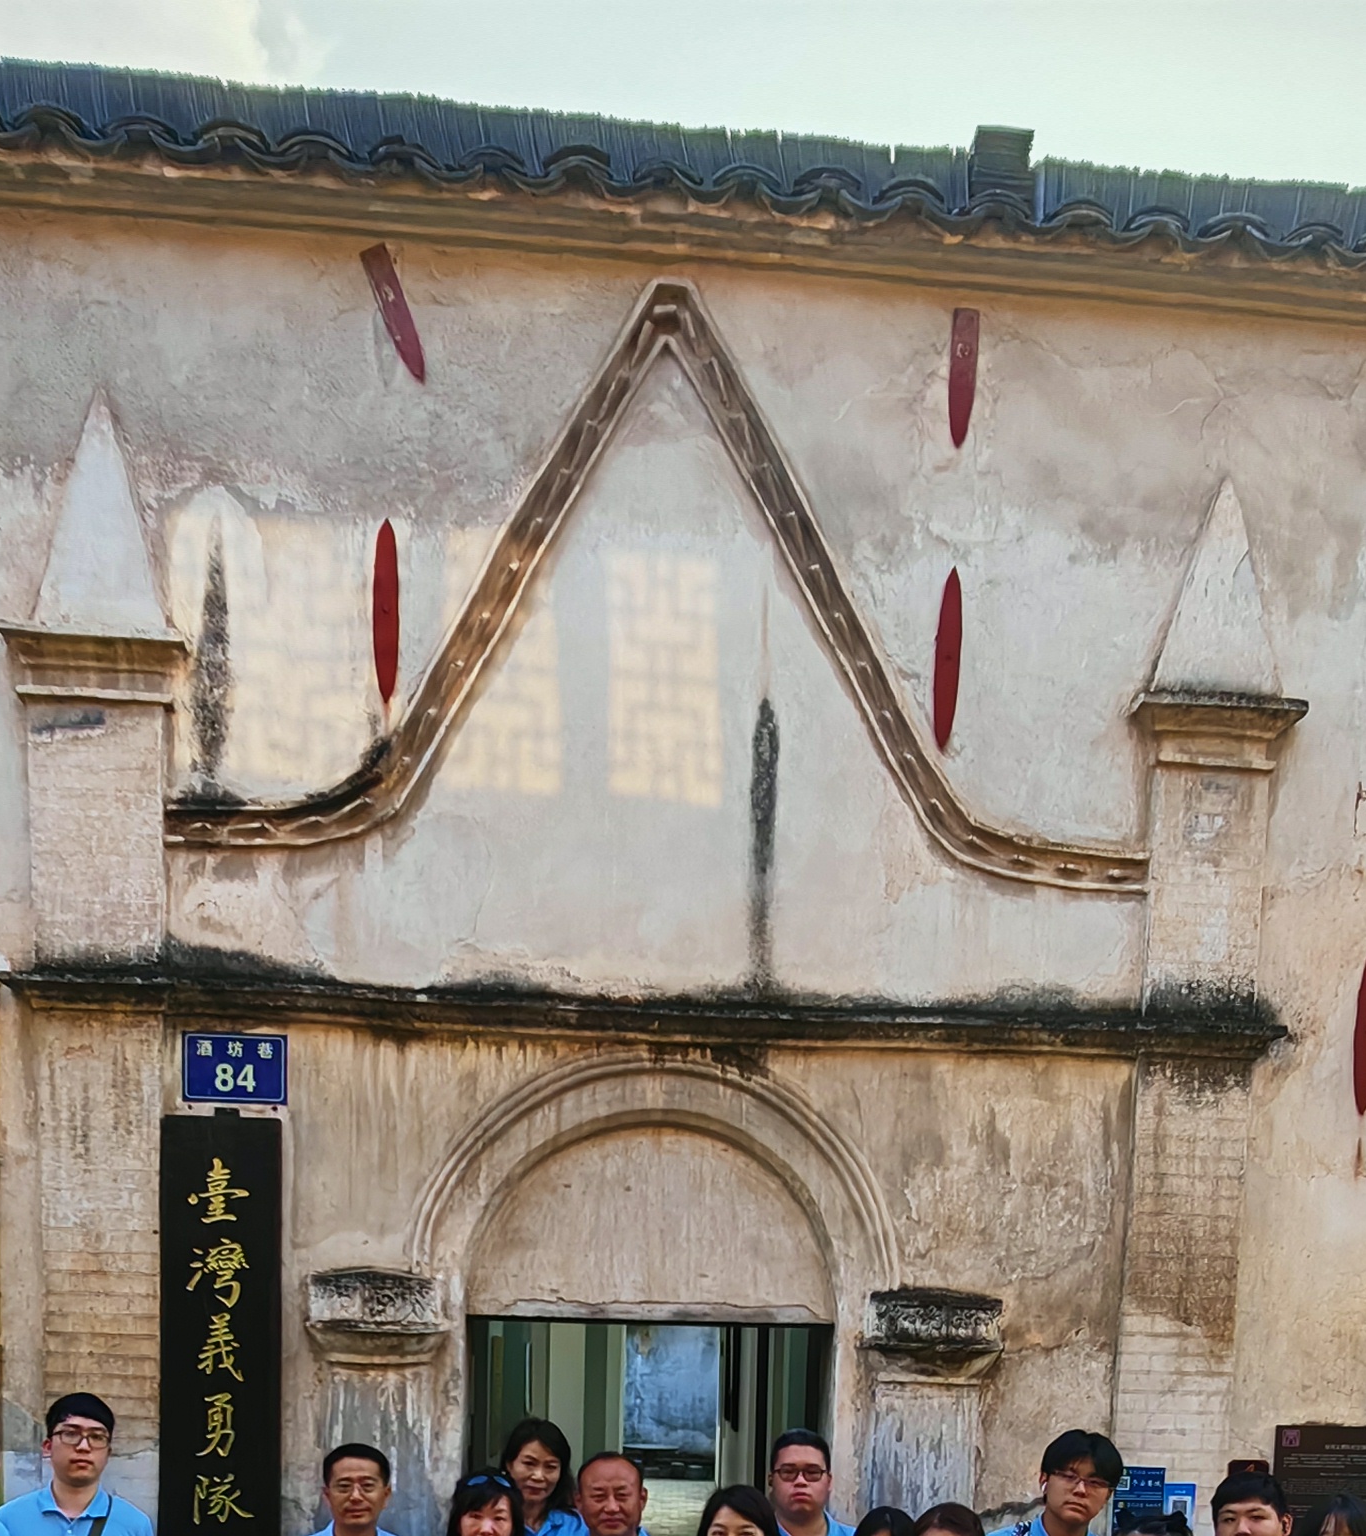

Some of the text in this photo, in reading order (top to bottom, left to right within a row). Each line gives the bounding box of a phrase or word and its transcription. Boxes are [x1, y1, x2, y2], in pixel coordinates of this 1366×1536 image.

[196, 1039, 274, 1059] 酒坊巷
[214, 1063, 256, 1093] 84
